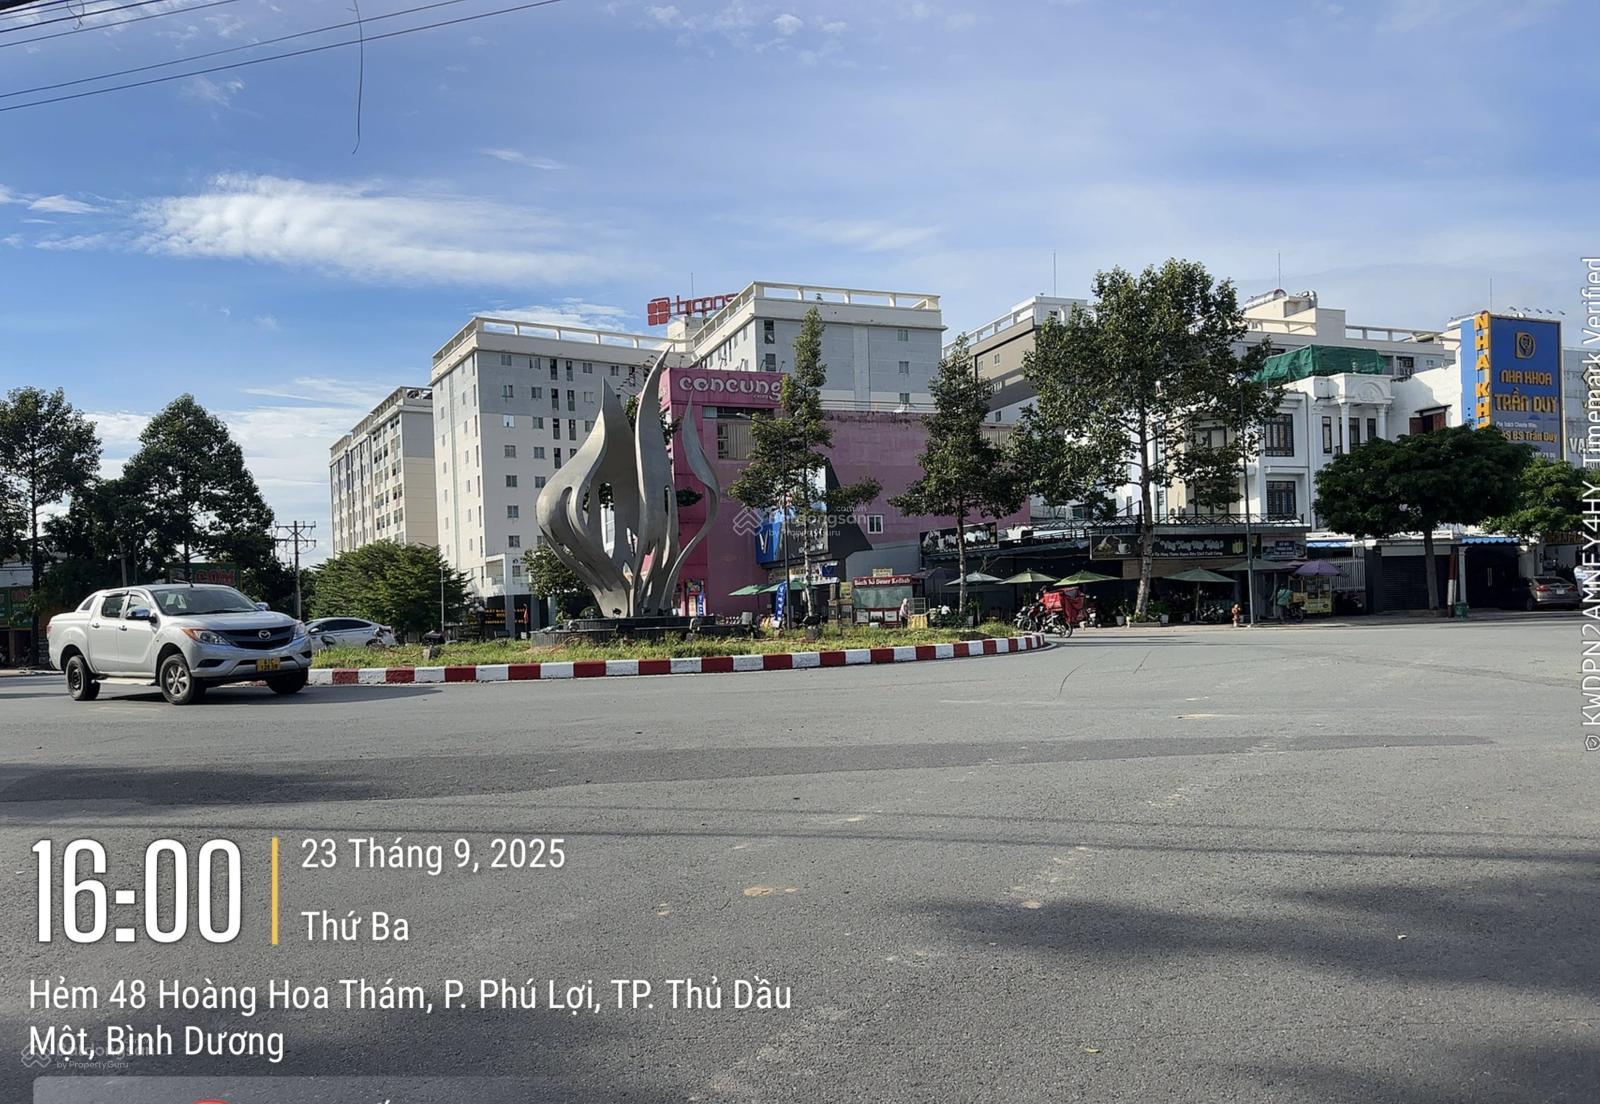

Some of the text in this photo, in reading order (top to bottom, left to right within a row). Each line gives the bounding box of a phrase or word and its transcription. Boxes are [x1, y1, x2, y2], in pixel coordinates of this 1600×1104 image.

[1474, 313, 1489, 371] NHA
[1525, 371, 1553, 385] KHOA
[680, 377, 782, 401] concung
[1532, 396, 1558, 414] DUY
